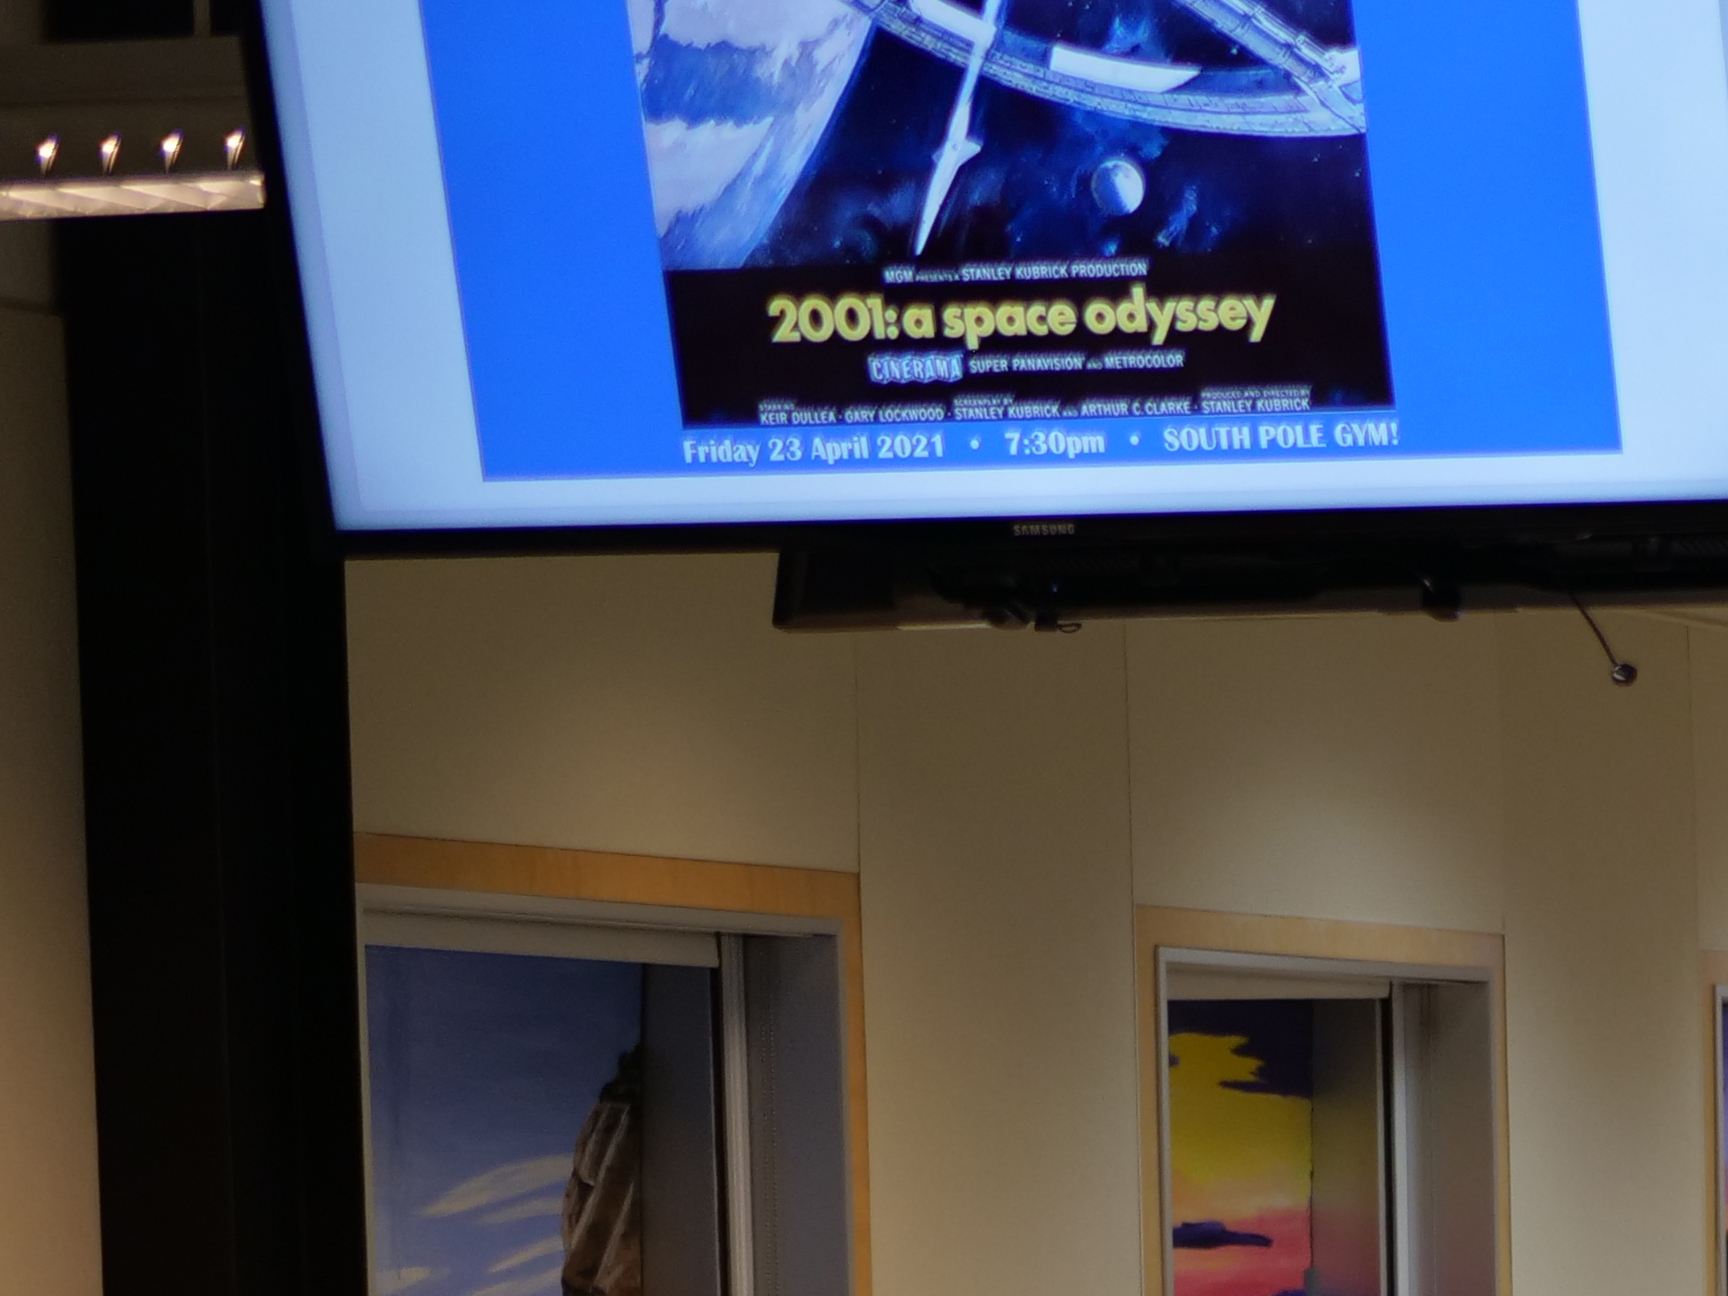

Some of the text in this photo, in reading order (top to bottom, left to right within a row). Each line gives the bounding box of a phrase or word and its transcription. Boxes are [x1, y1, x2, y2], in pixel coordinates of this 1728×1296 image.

[884, 269, 914, 283] MGM
[961, 267, 1013, 281] STANLEY
[1015, 264, 1068, 279] KUBRICK
[1070, 262, 1148, 277] PRODUCTION
[943, 302, 1077, 350] space
[1084, 282, 1277, 345] odyssey
[869, 354, 963, 383] CINERAMA
[969, 357, 1009, 374] SUPER
[1104, 353, 1185, 369] METROCOLOR
[761, 412, 788, 425] KEIR
[791, 411, 836, 424] DULLEA
[845, 410, 876, 423] GARY
[878, 408, 944, 422] LOCKWOOD
[954, 406, 1004, 420] STANLEY
[1008, 404, 1060, 418] KUBRICK
[1081, 402, 1128, 416] ARTHUR
[1145, 401, 1191, 414] CLARKE
[1202, 400, 1252, 414] STANLEY
[1256, 397, 1310, 411] KUBRICK
[682, 421, 1399, 467] Friday 23 April 2021 7:30pm SOUTH POLE GYM!
[1013, 524, 1075, 536] SAMSUNG
